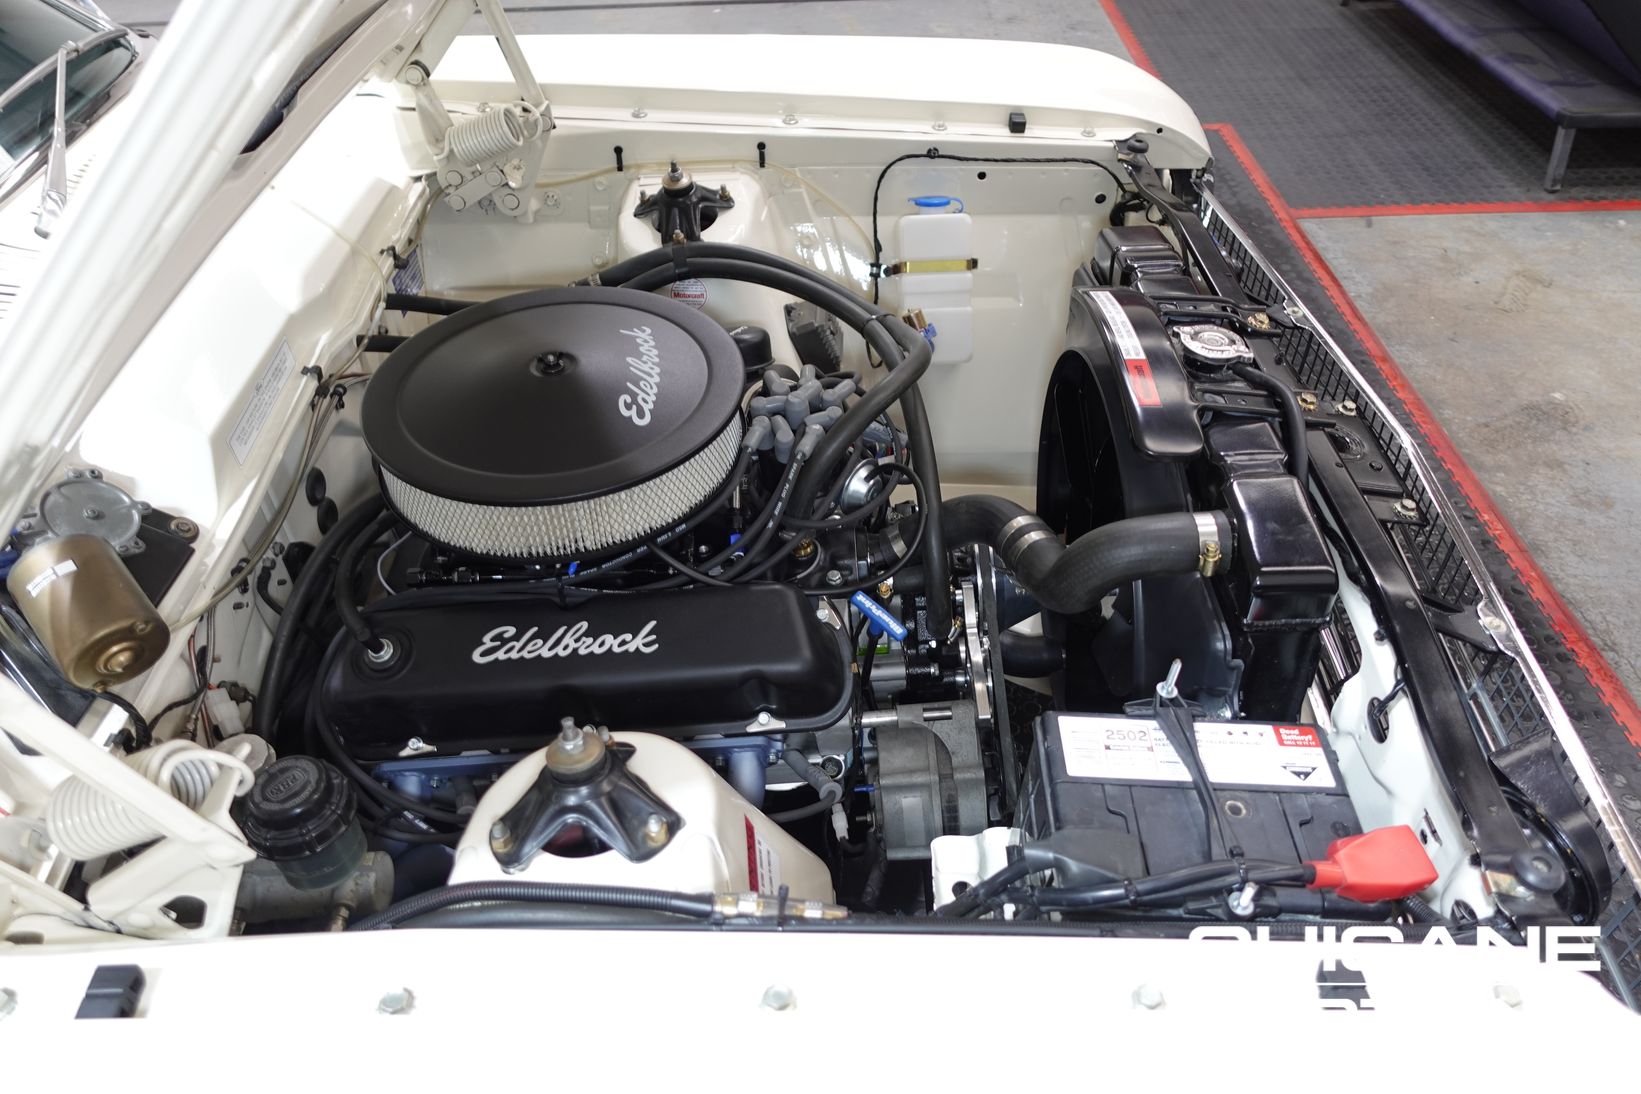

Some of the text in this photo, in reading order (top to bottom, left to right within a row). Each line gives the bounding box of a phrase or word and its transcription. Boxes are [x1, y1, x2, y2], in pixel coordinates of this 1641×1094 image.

[618, 324, 662, 427] Edelbrock
[780, 482, 790, 499] PLUG
[854, 592, 905, 637] BluePrint
[471, 618, 661, 665] Edelbrock
[1105, 729, 1148, 742] 2502
